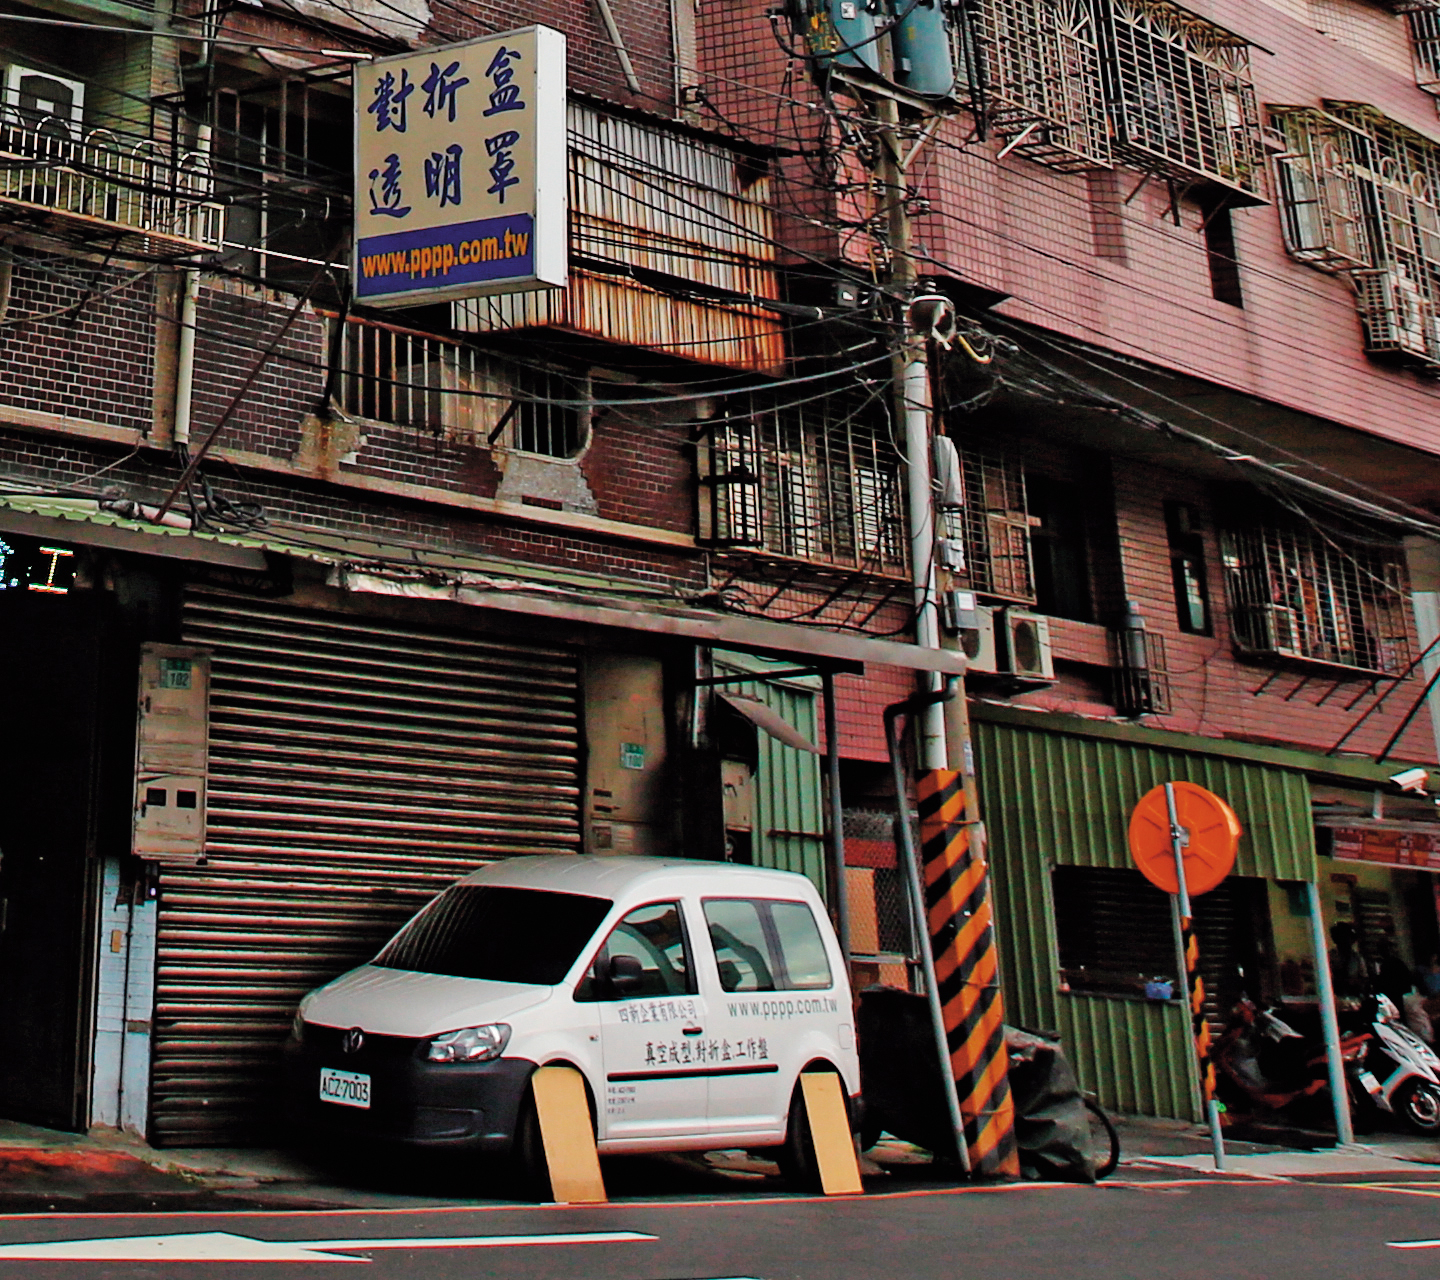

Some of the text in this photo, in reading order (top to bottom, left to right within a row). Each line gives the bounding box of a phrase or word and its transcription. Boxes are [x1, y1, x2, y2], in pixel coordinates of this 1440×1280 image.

[367, 46, 527, 134] 對折盒
[368, 129, 522, 219] 透明罩
[361, 226, 529, 280] www.pppp.com.tw
[727, 996, 838, 1021] www.pppp.com.tw
[322, 1077, 369, 1102] ACZ-7003
